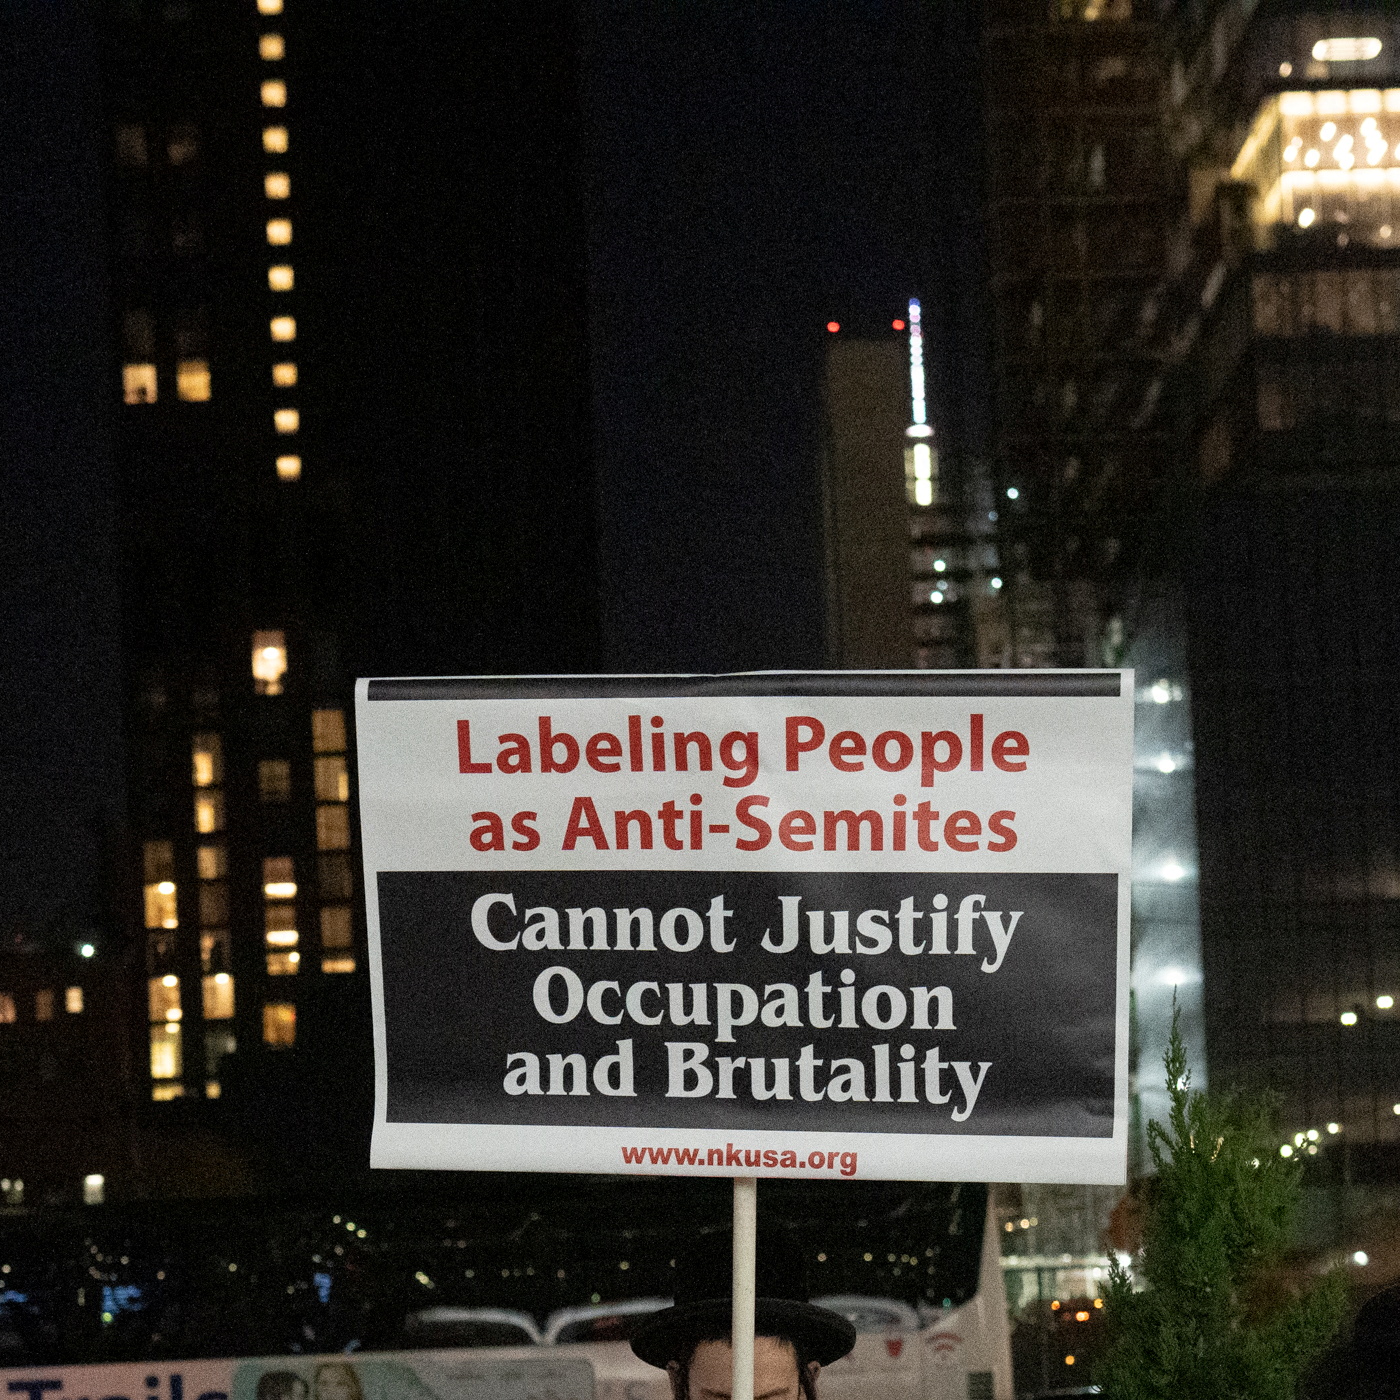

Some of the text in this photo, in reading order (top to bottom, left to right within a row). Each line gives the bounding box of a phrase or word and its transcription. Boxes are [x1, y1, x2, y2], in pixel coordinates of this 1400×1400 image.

[457, 714, 1030, 787] Labeling People
[469, 794, 1018, 853] as Anti-Semites
[471, 893, 1024, 974] Cannot Justify
[533, 966, 956, 1042] Occupation
[503, 1039, 992, 1122] and Brutality
[621, 1144, 858, 1176] www.nkusa.org
